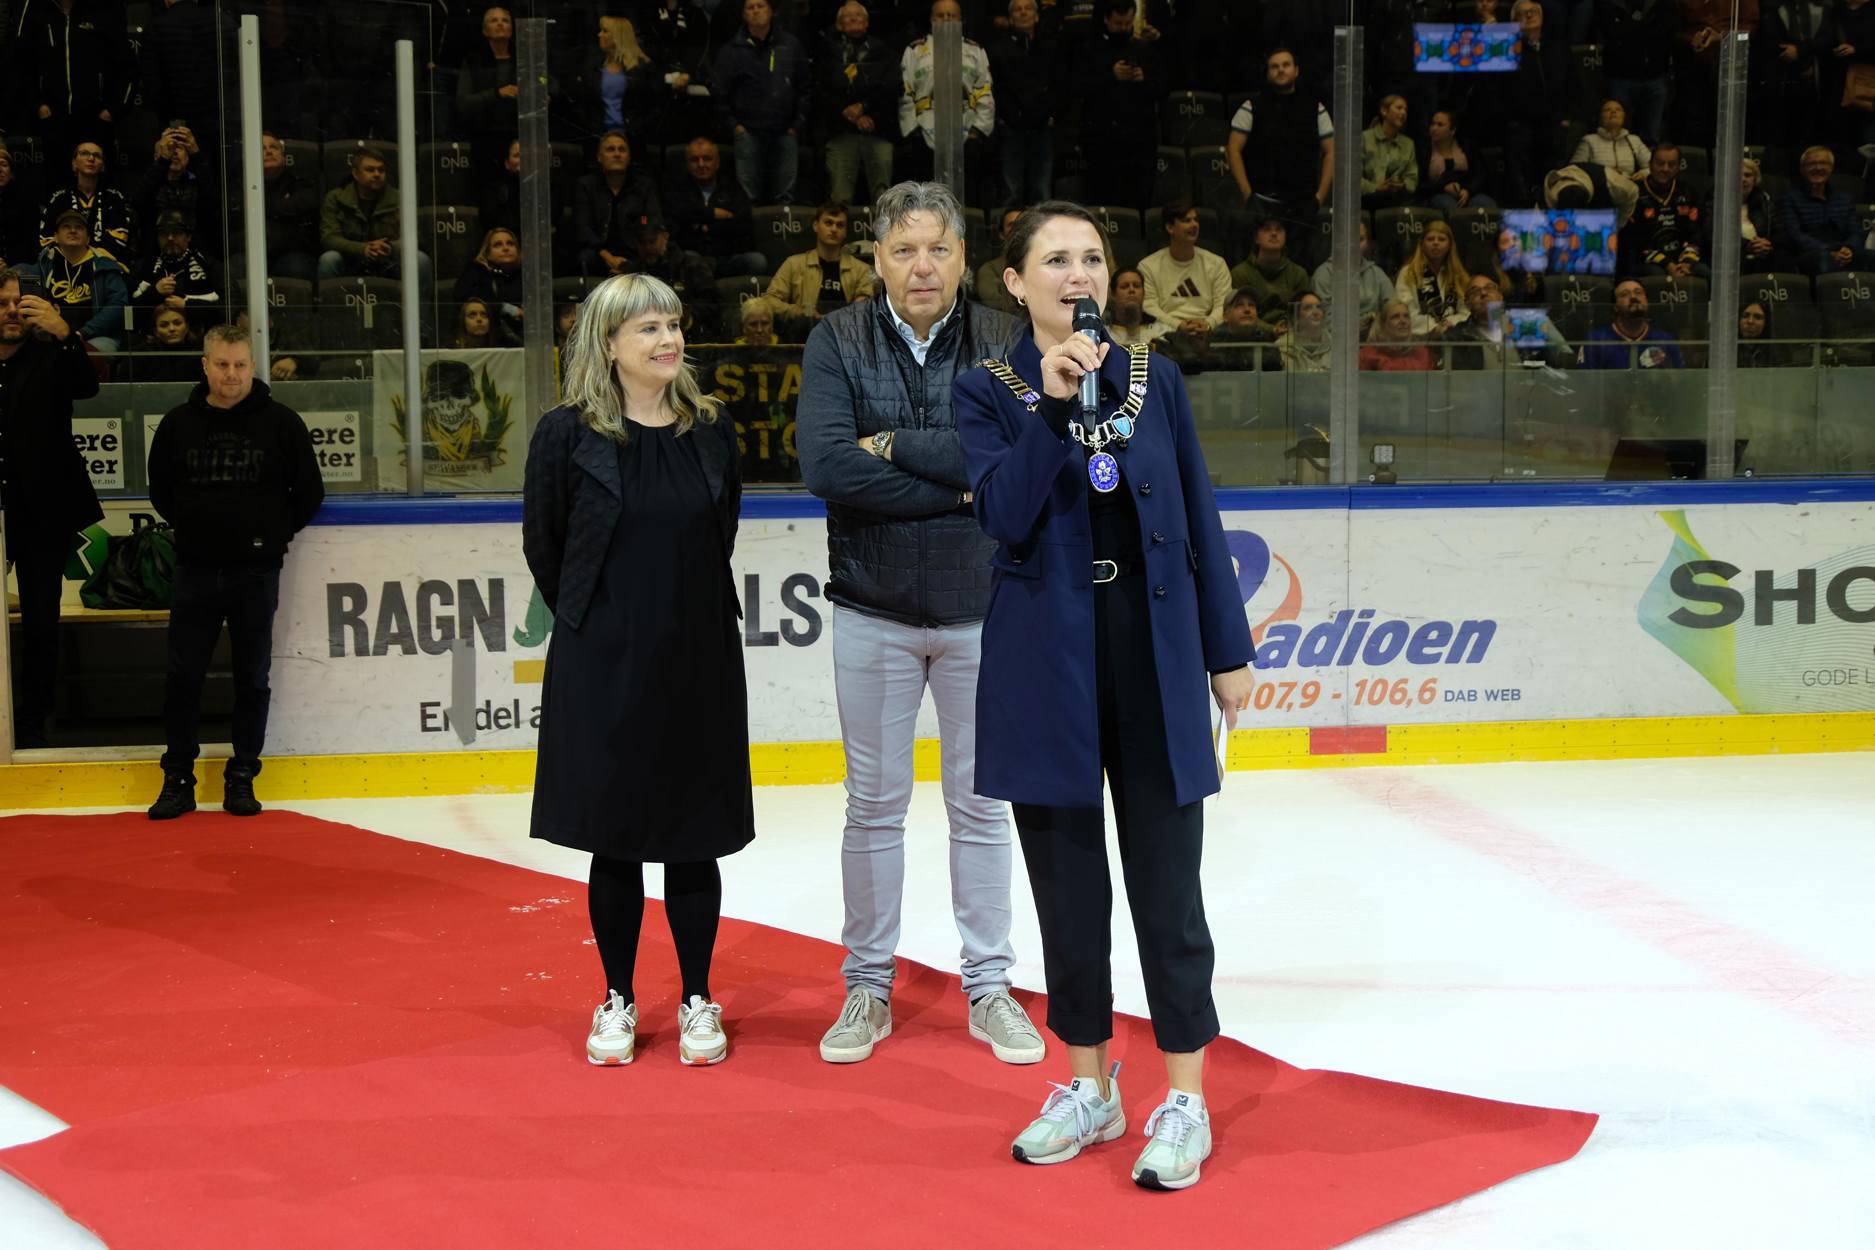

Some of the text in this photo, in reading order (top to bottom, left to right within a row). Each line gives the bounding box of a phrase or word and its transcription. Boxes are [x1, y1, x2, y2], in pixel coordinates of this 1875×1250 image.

[441, 156, 470, 168] DNB
[1211, 159, 1231, 170] DN
[437, 221, 466, 233] DNB
[773, 221, 801, 233] DNB
[854, 221, 873, 232] DN
[1100, 222, 1119, 232] NB
[1396, 222, 1424, 234] DNB
[1562, 290, 1591, 303] DNB
[1660, 290, 1688, 303] DNB
[1759, 288, 1789, 301] DNB
[1841, 287, 1871, 300] DNB
[268, 294, 286, 306] NB
[345, 294, 377, 306] DNB
[326, 578, 507, 658] RAGN
[1802, 668, 1858, 687] GODE
[1353, 677, 1439, 708] 106,6
[1443, 689, 1478, 703] DAB
[1485, 688, 1522, 701] WEB
[475, 698, 521, 731] del
